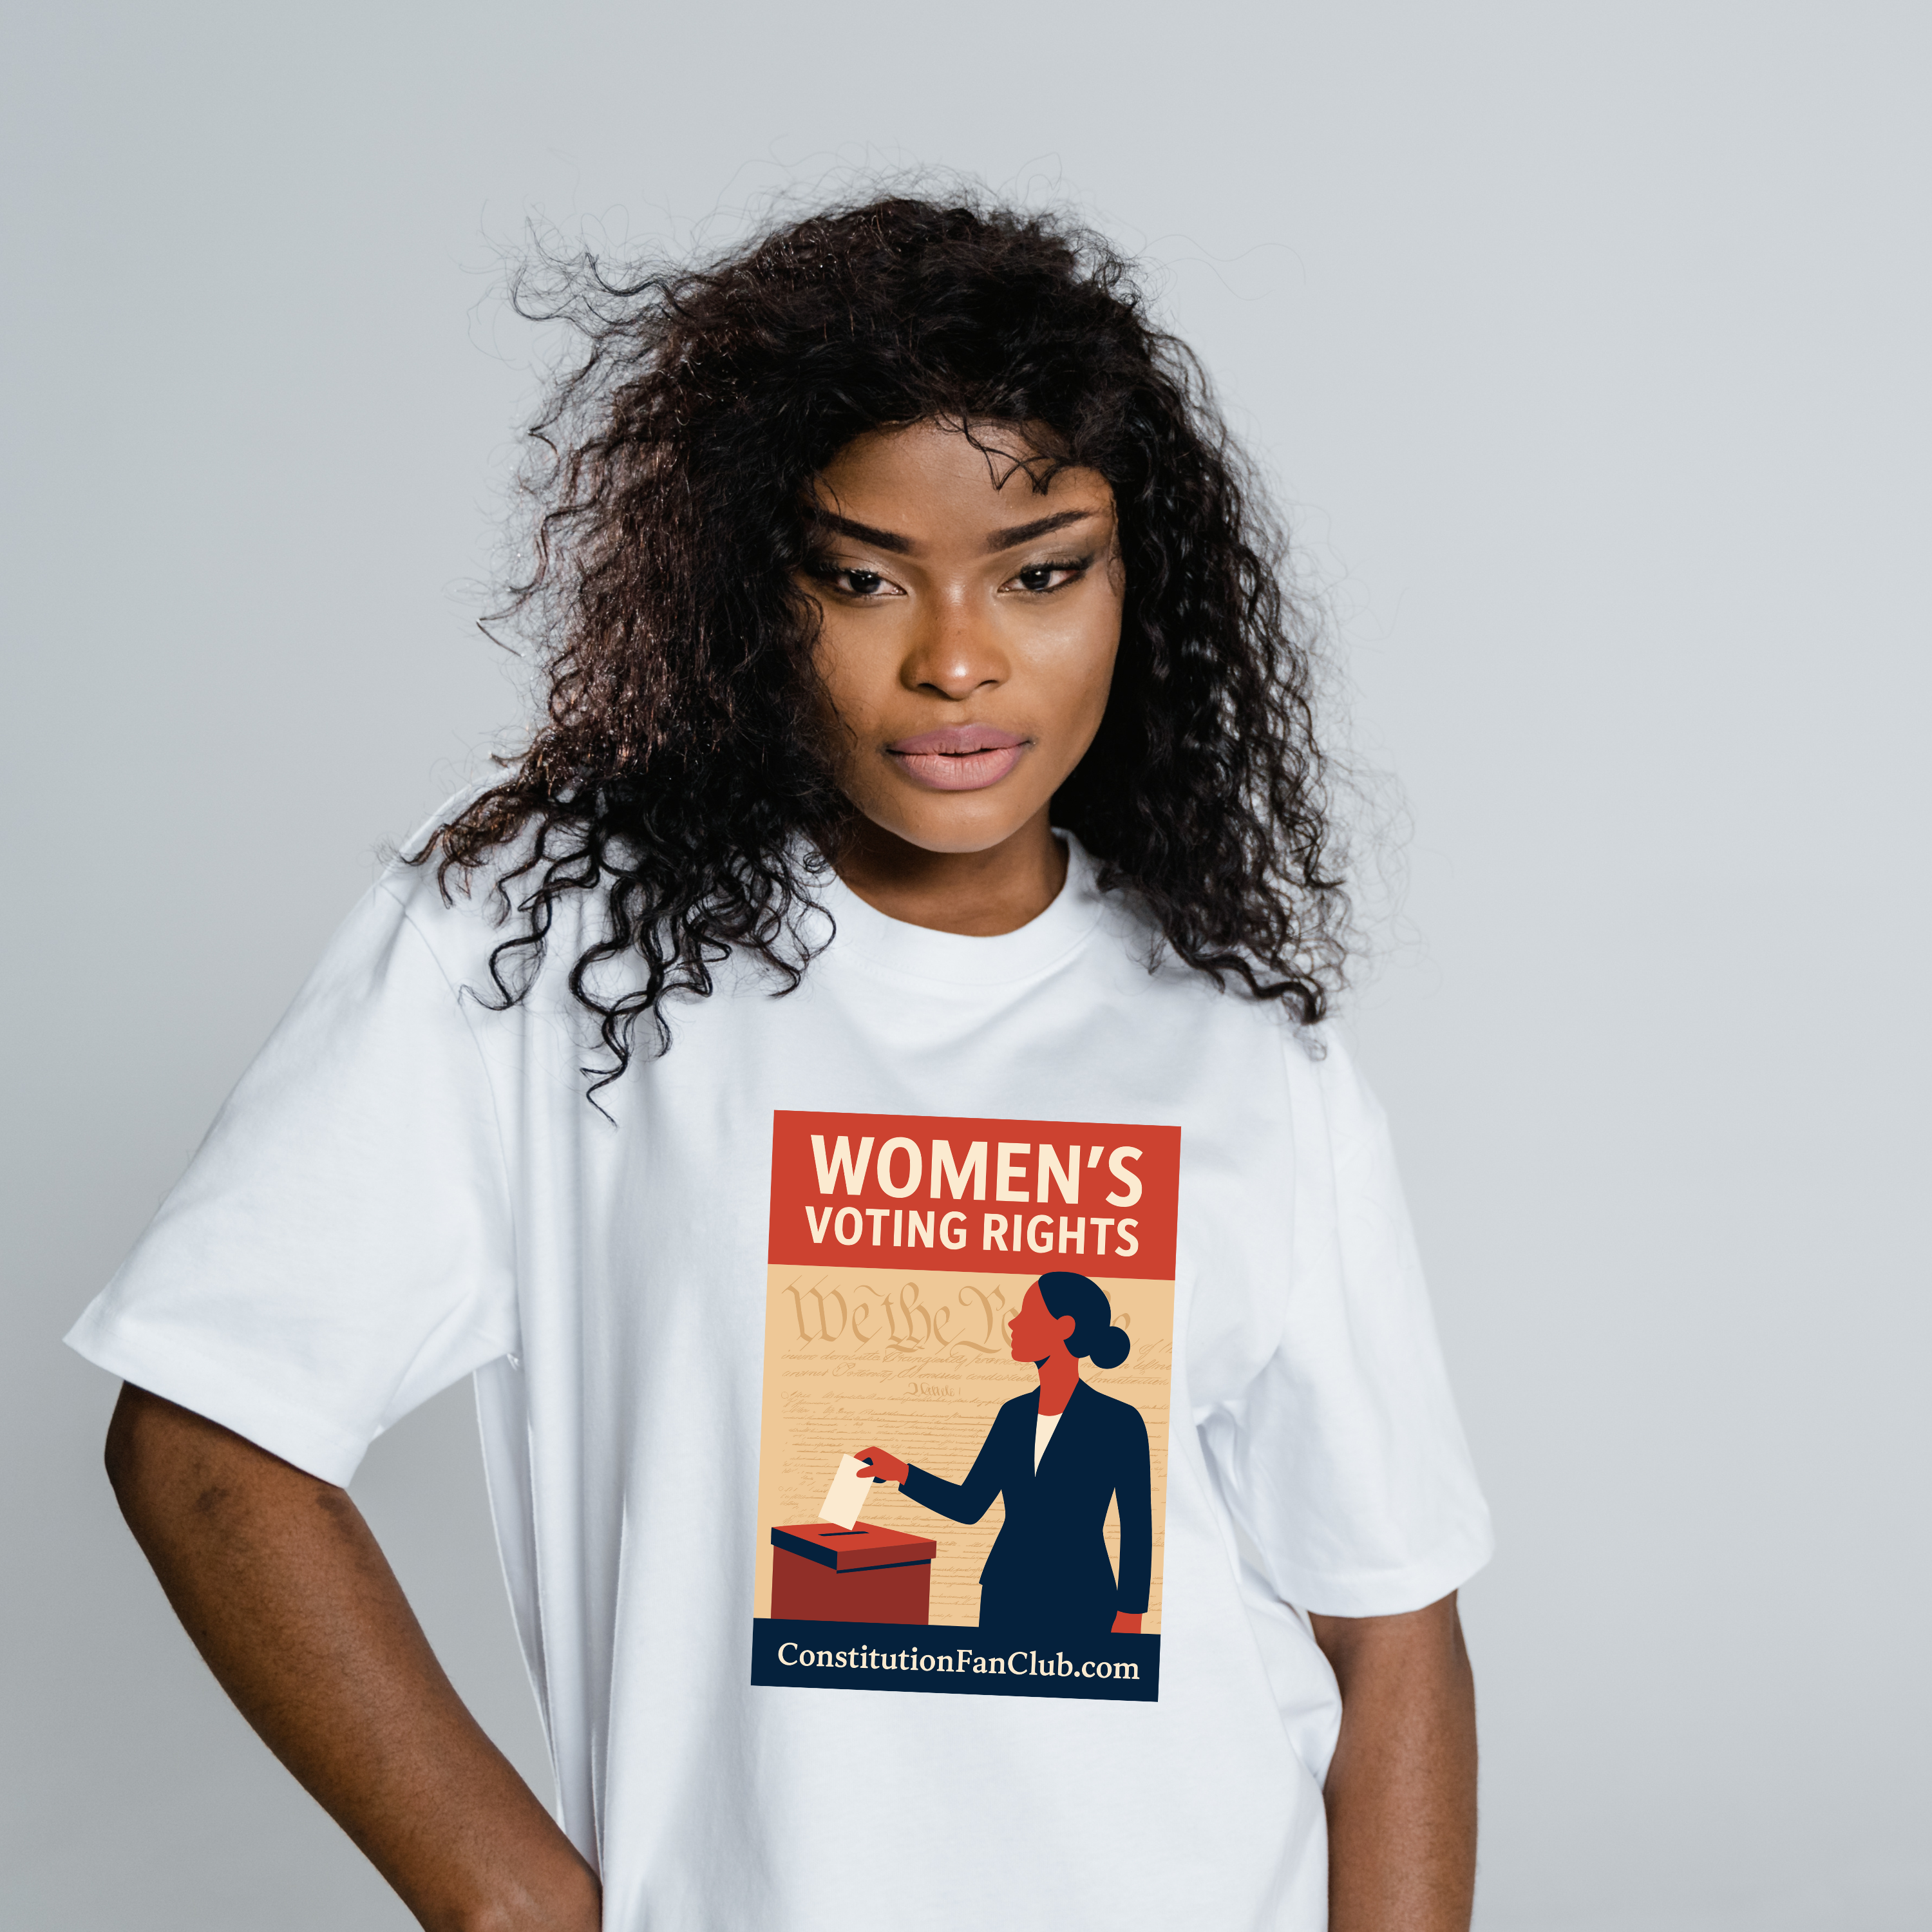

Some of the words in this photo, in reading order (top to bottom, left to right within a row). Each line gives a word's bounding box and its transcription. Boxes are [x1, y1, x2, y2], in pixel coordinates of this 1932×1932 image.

[810, 1134, 1143, 1208] WOMEN'S
[805, 1206, 967, 1250] VOTING
[983, 1213, 1139, 1257] RIGHTS
[781, 1274, 884, 1352] We
[880, 1282, 966, 1355] the
[777, 1642, 1140, 1680] ConstitutionFanClub.com
